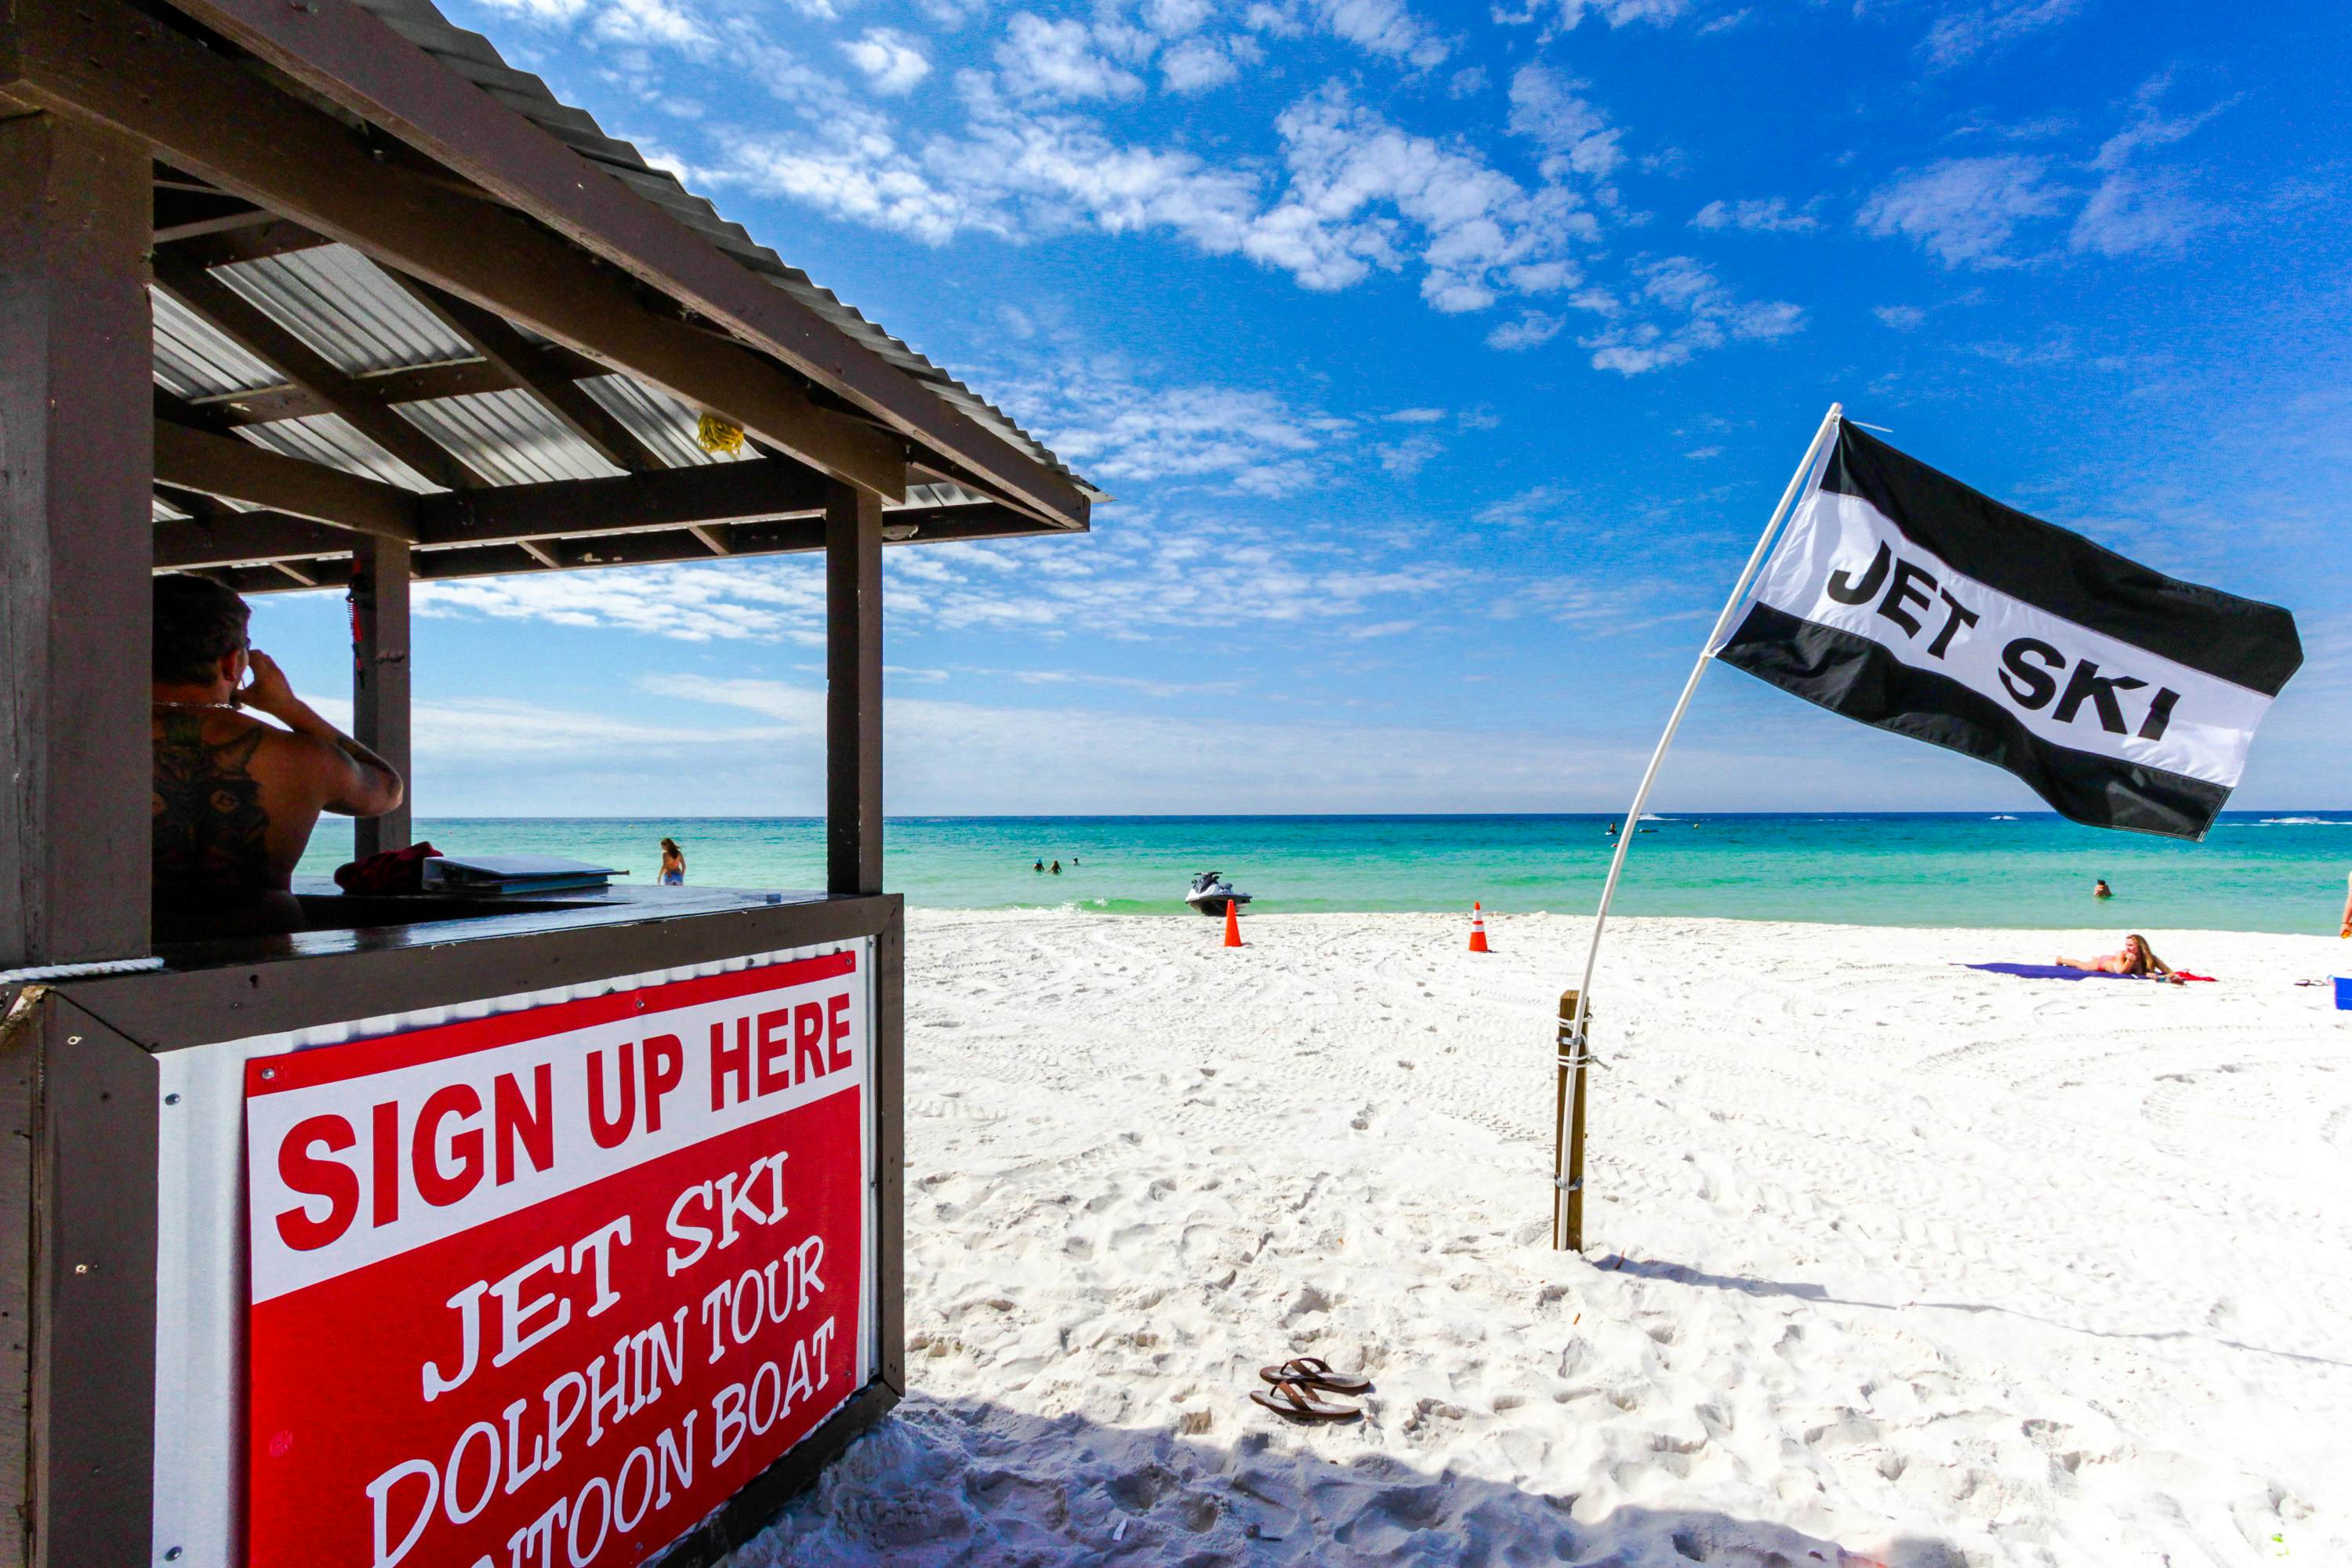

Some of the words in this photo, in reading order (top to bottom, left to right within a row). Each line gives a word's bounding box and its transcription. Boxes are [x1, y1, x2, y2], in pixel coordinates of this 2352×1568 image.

[1827, 540, 1980, 659] JET
[1998, 638, 2180, 741] SKI
[275, 1063, 554, 1251] SIGN
[586, 1034, 684, 1148] UP
[710, 993, 852, 1112] HERE
[423, 1215, 631, 1401] JET
[667, 1152, 789, 1276] SKI
[712, 1318, 834, 1468] BOAT
[366, 1306, 688, 1568] DOLPHIN
[702, 1236, 825, 1363] TOUR
